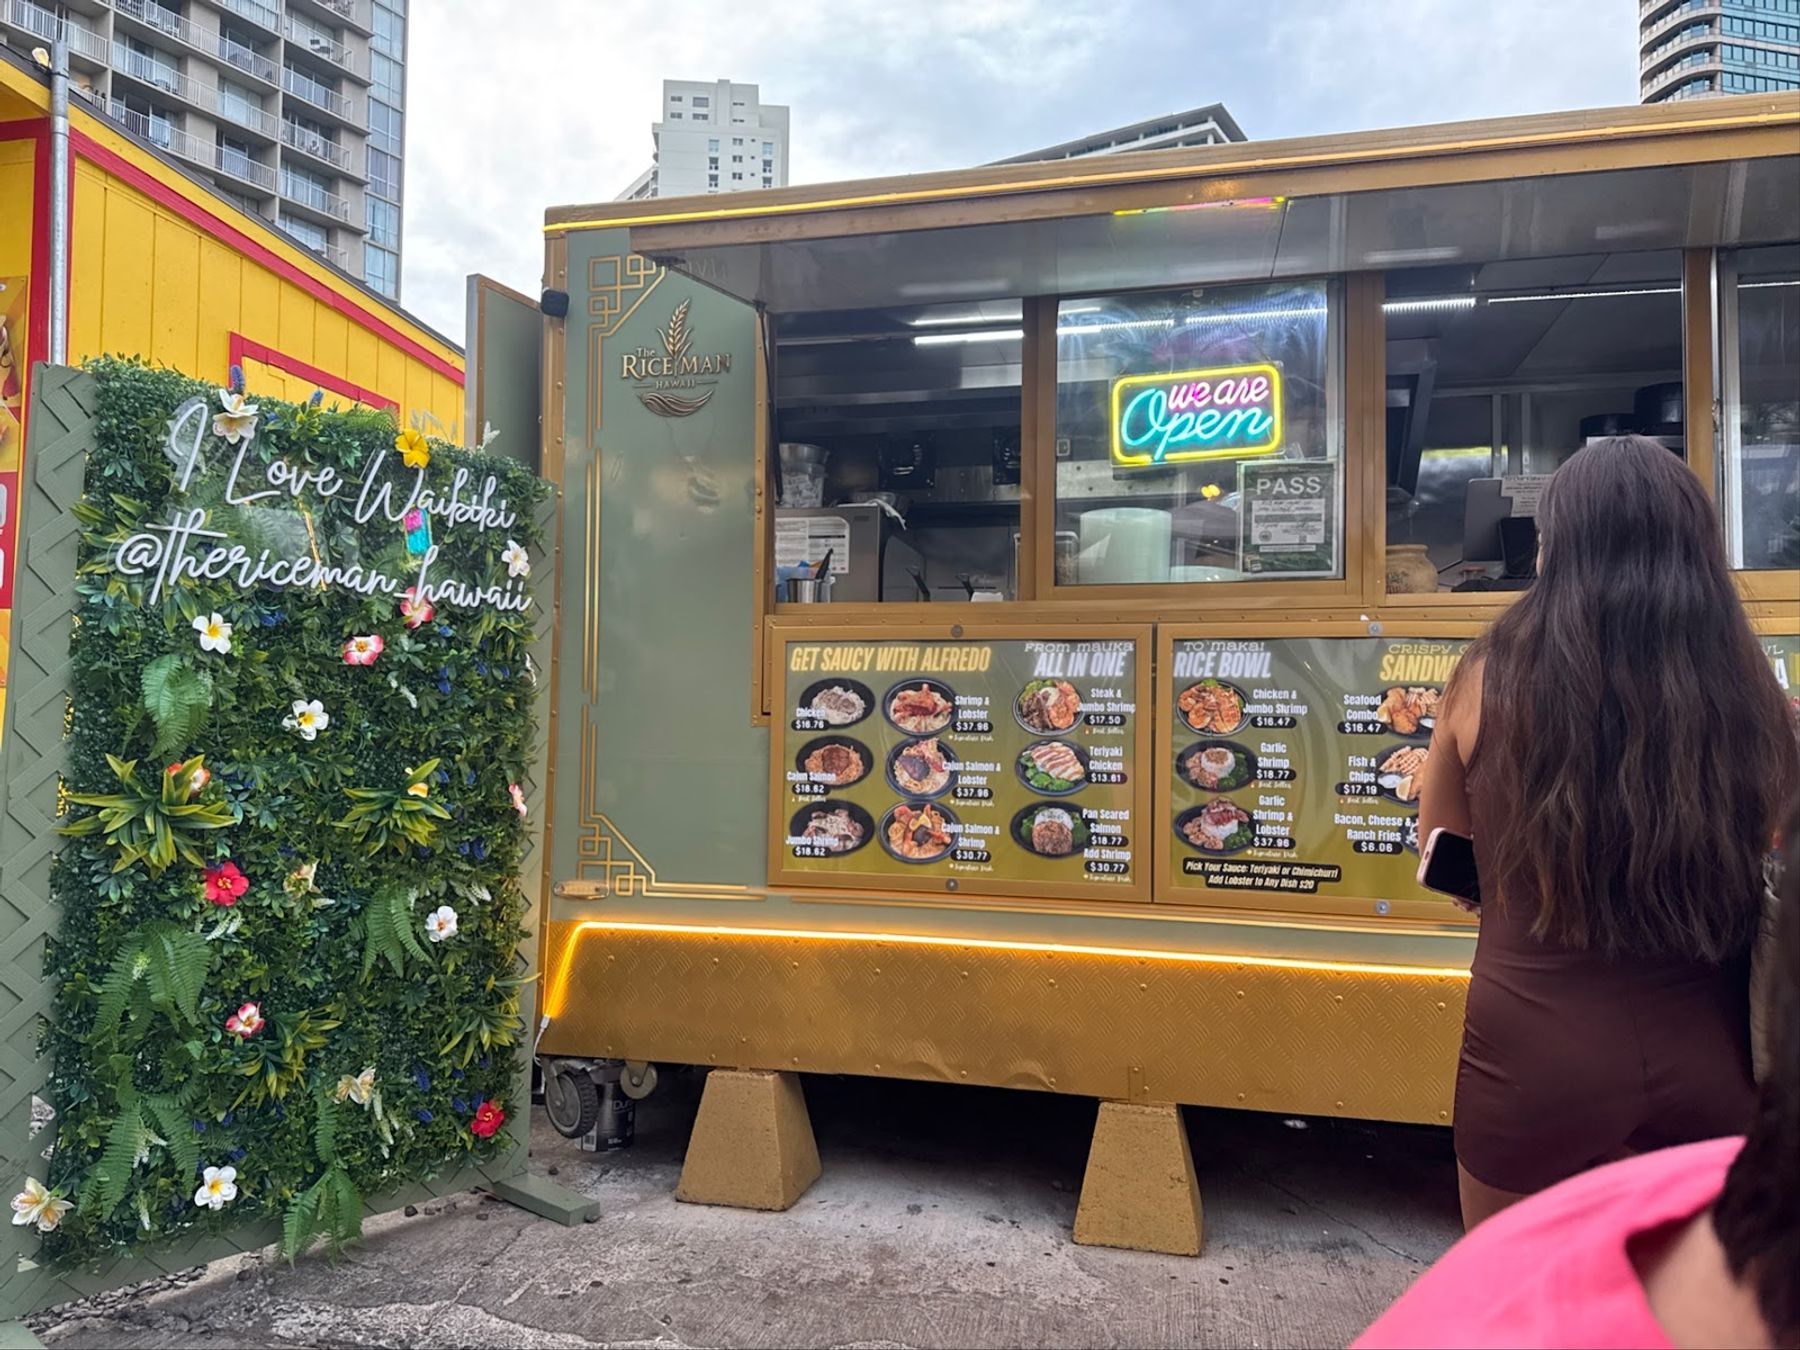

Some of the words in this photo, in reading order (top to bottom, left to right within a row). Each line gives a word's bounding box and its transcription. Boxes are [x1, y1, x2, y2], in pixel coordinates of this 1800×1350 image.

[679, 353, 732, 375] MAN
[1168, 381, 1211, 410] we
[1213, 376, 1270, 405] are
[1121, 388, 1274, 460] Open
[169, 398, 209, 492] I
[225, 436, 343, 505] Love
[354, 449, 517, 530] Waikiki
[1256, 476, 1323, 496] PASS
[114, 508, 533, 612] @thericeman_hawaii
[1388, 644, 1453, 655] CRISPY
[790, 646, 821, 672] GET
[820, 646, 875, 672] SAUCY
[875, 646, 918, 672] WITH
[920, 646, 992, 672] ALFREDO
[1033, 652, 1065, 677] ALL
[1067, 652, 1089, 677] IN
[1090, 652, 1127, 677] ONE
[1173, 652, 1217, 678] RICE
[1217, 652, 1272, 678] BOWL
[1379, 654, 1461, 682] SANDW
[1091, 688, 1115, 699] Steak
[1116, 689, 1122, 698] &
[1253, 689, 1289, 700] Chicken
[1290, 690, 1297, 699] &
[955, 696, 984, 707] Shrimp
[985, 696, 990, 705] &
[1343, 694, 1382, 705] Seafood
[1107, 702, 1136, 714] Shrimp
[1243, 703, 1274, 714] Jumbo
[1275, 704, 1308, 716] Shrimp
[958, 709, 989, 720] Lobster
[1089, 715, 1121, 725] $17.50
[1346, 709, 1379, 720] Combo
[1089, 746, 1123, 757] Teriyaki
[1260, 742, 1287, 753] Garlic
[965, 762, 995, 771] Salmon
[1089, 760, 1123, 771] Chicken
[1257, 757, 1290, 769] Shrimp
[1347, 756, 1368, 767] Fish
[1370, 758, 1377, 767] &
[1256, 769, 1291, 780] $18.77
[1348, 771, 1376, 783] Chips
[957, 775, 988, 786] Lobster
[1343, 784, 1378, 795] $17.19
[1258, 795, 1286, 806] Garlic
[1082, 809, 1098, 819] Pan
[1100, 809, 1130, 819] Seared
[1252, 810, 1285, 822] Shrimp
[1287, 811, 1293, 821] &
[1334, 814, 1367, 827] Bacon,
[1368, 815, 1403, 826] Cheese
[1405, 817, 1412, 827] &
[964, 824, 994, 834] Salmon
[1089, 823, 1122, 833] Salmon
[1255, 824, 1291, 836] Lobster
[1346, 829, 1376, 840] Ranch
[1378, 830, 1402, 841] Fries
[957, 838, 986, 849] Shrimp
[956, 851, 988, 862] $30.77
[1083, 848, 1100, 859] Add
[1101, 849, 1132, 861] Shrimp
[1090, 862, 1125, 873] $30.77
[1185, 861, 1203, 871] Pick
[1204, 862, 1222, 872] Your
[1222, 863, 1249, 873] Sauce:
[1250, 864, 1281, 876] Teriyaki
[1281, 866, 1291, 875] or
[1291, 866, 1339, 879] Chimichurri
[1208, 875, 1224, 884] Add
[1224, 876, 1254, 886] Lobster
[1255, 876, 1263, 886] to
[1264, 878, 1280, 889] Any
[1280, 879, 1298, 889] Dish
